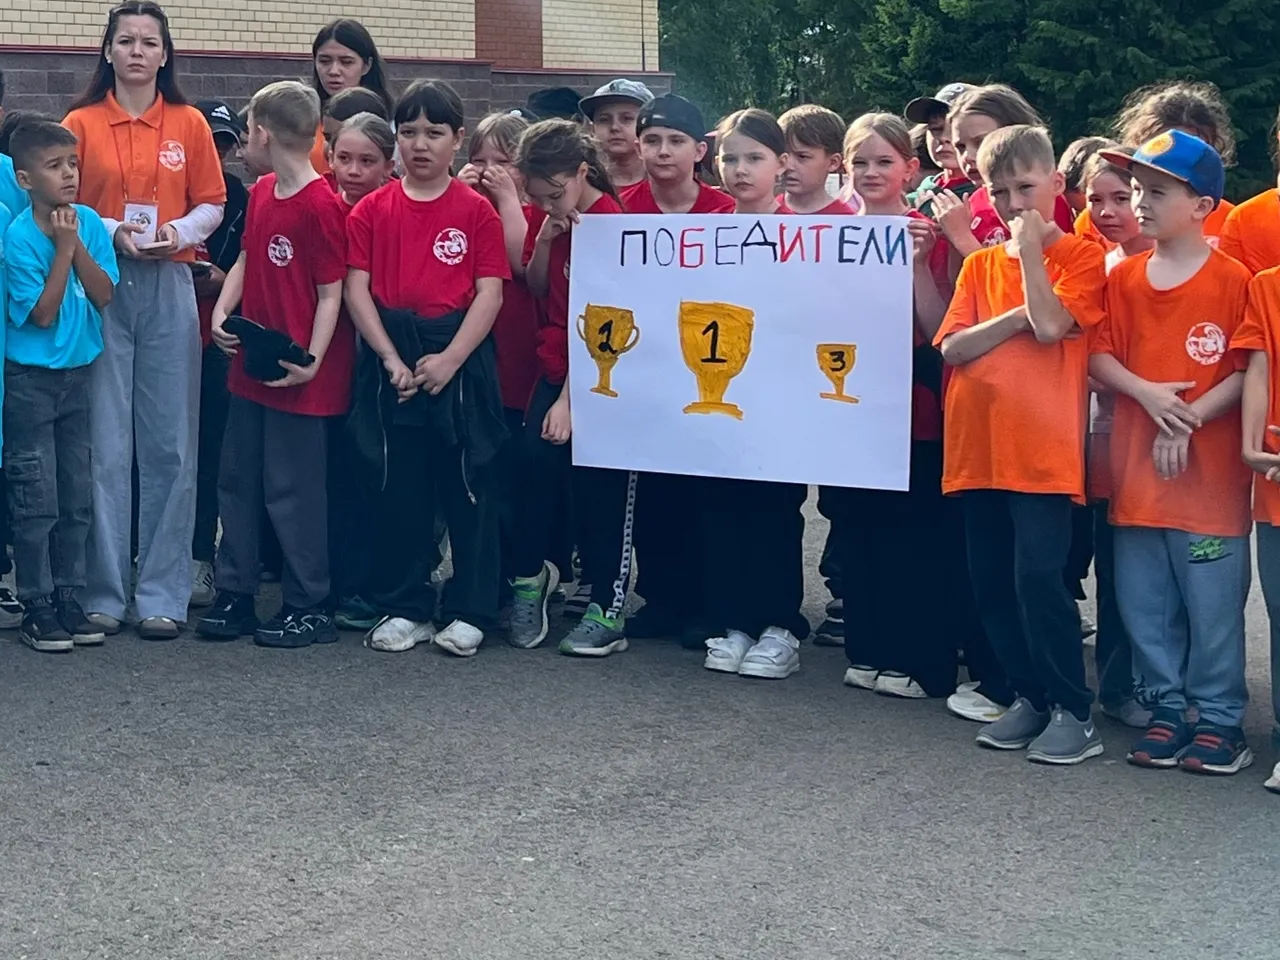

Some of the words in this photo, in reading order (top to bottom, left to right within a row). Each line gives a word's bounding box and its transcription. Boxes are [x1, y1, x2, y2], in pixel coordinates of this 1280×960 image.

[620, 220, 908, 268] ПОБЕДИТЕЛИ
[597, 319, 618, 356] 2
[700, 320, 728, 364] 1
[828, 350, 846, 372] 3
